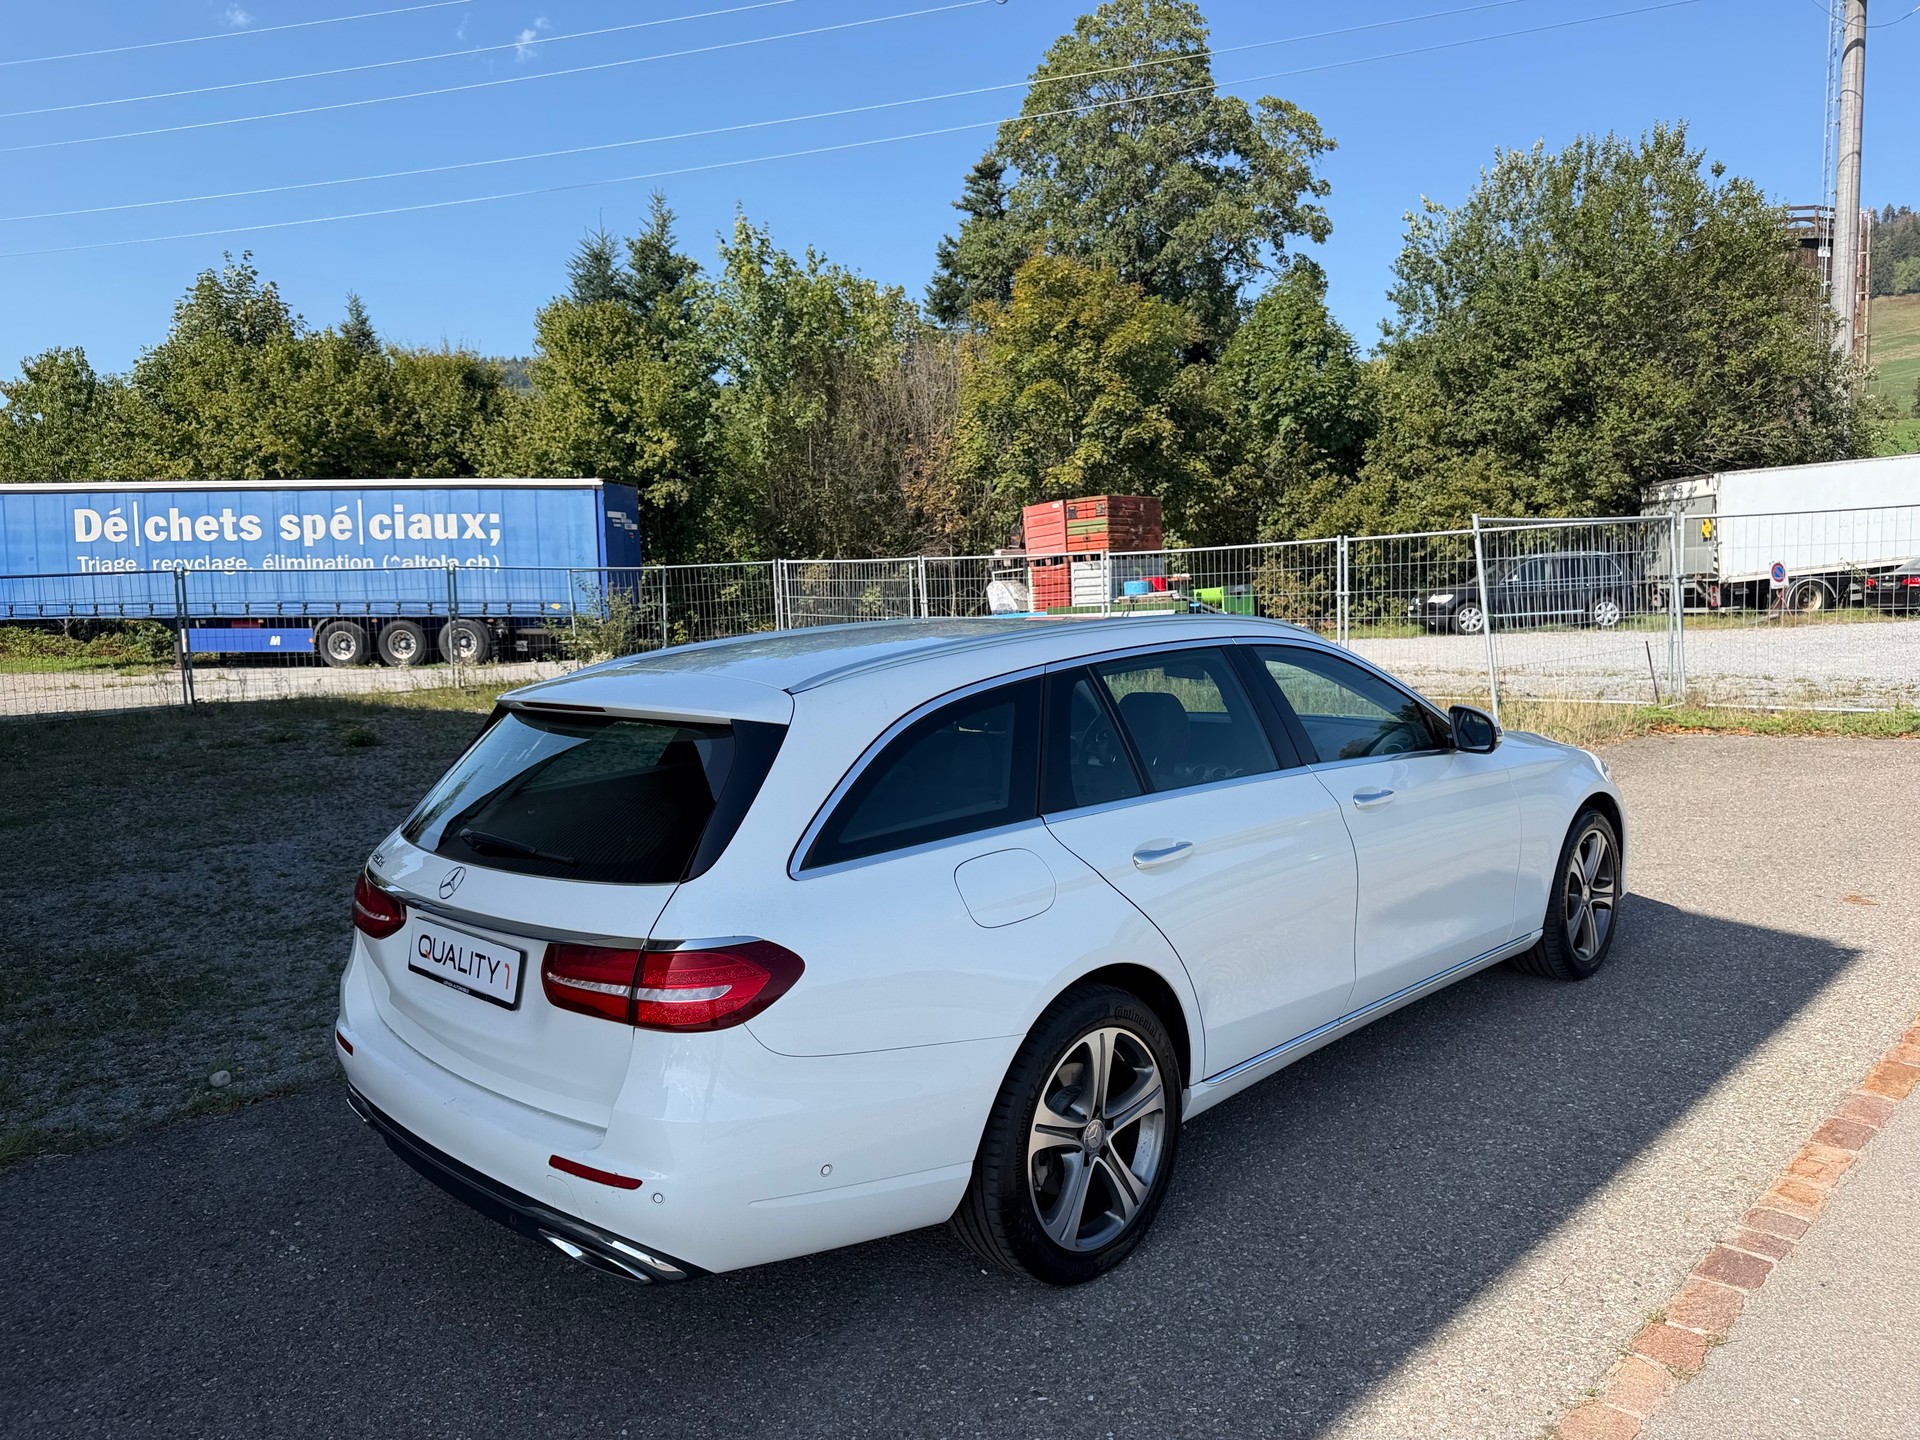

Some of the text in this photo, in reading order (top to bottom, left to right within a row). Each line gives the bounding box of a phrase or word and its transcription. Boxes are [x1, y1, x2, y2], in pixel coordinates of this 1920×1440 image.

[262, 553, 375, 570] élimination
[418, 934, 501, 984] QUALITY
[1114, 1006, 1158, 1038] Continental
